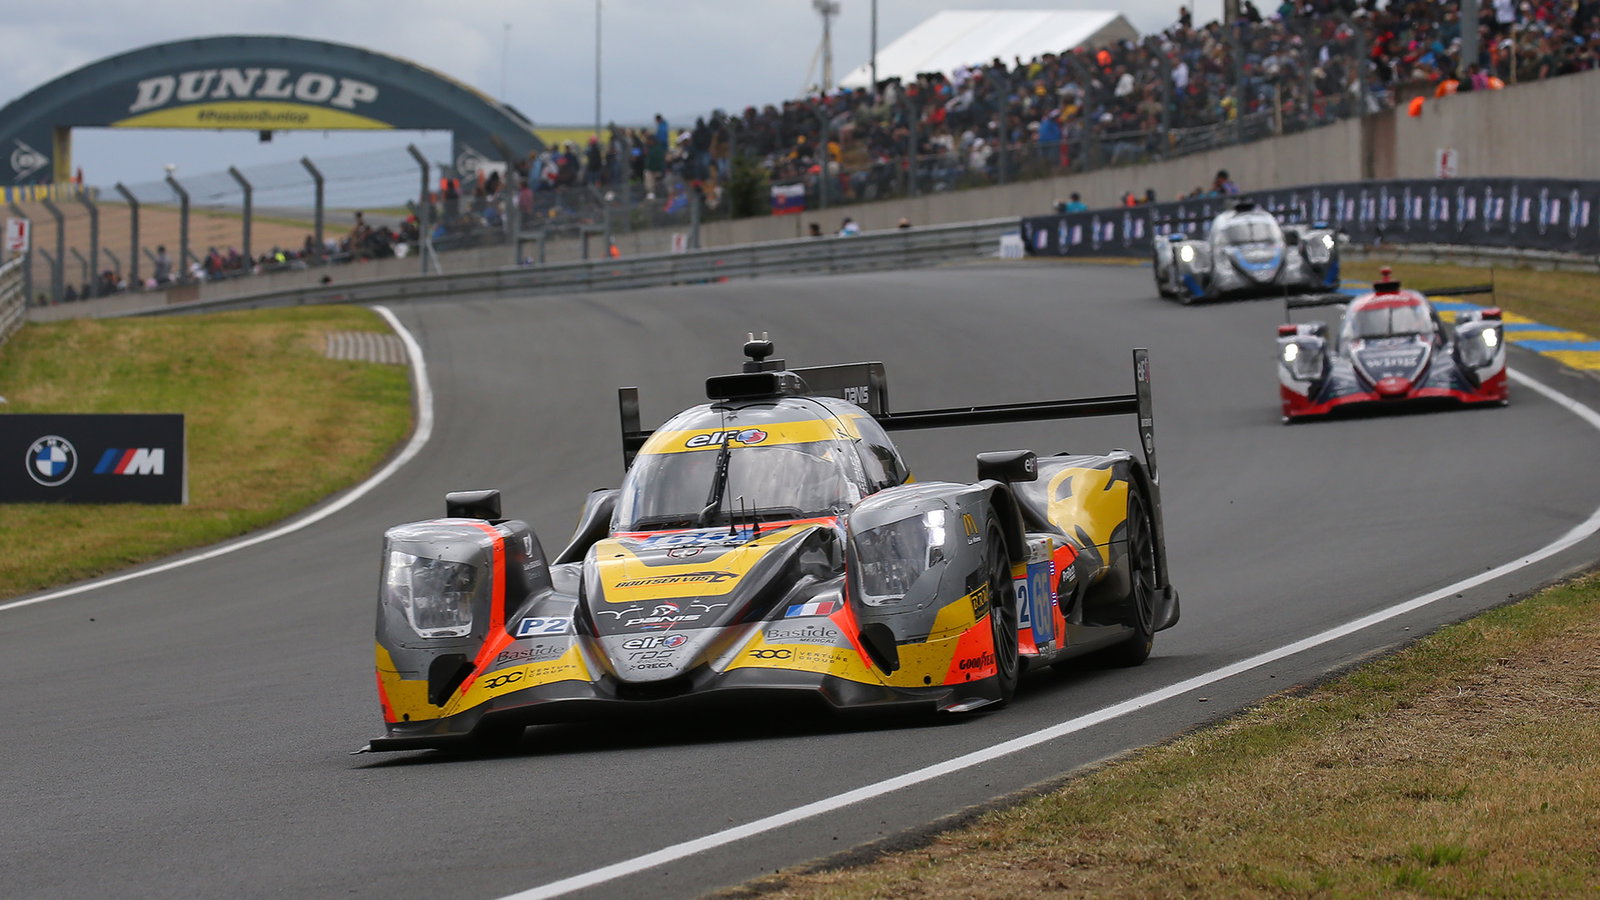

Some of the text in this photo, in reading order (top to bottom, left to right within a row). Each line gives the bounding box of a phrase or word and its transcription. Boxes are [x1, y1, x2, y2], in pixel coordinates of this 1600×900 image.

[129, 68, 379, 113] DUNLOP
[197, 109, 309, 124] #PassionDunlop
[686, 431, 740, 447] elf
[34, 439, 70, 453] BMW
[123, 448, 165, 475] M
[614, 578, 680, 588] BOUTSEN
[1033, 572, 1051, 636] 65
[520, 619, 567, 634] P2
[767, 626, 838, 638] Bastide
[622, 636, 668, 649] elf
[497, 644, 565, 663] Bastide
[628, 649, 676, 661] TDS
[749, 649, 793, 659] ROC
[798, 656, 835, 664] GROUP
[799, 651, 849, 662] VENTURE
[530, 664, 577, 674] VENTURE
[637, 662, 673, 670] ORECA
[529, 668, 564, 678] GROUP
[484, 671, 524, 689] ROC
